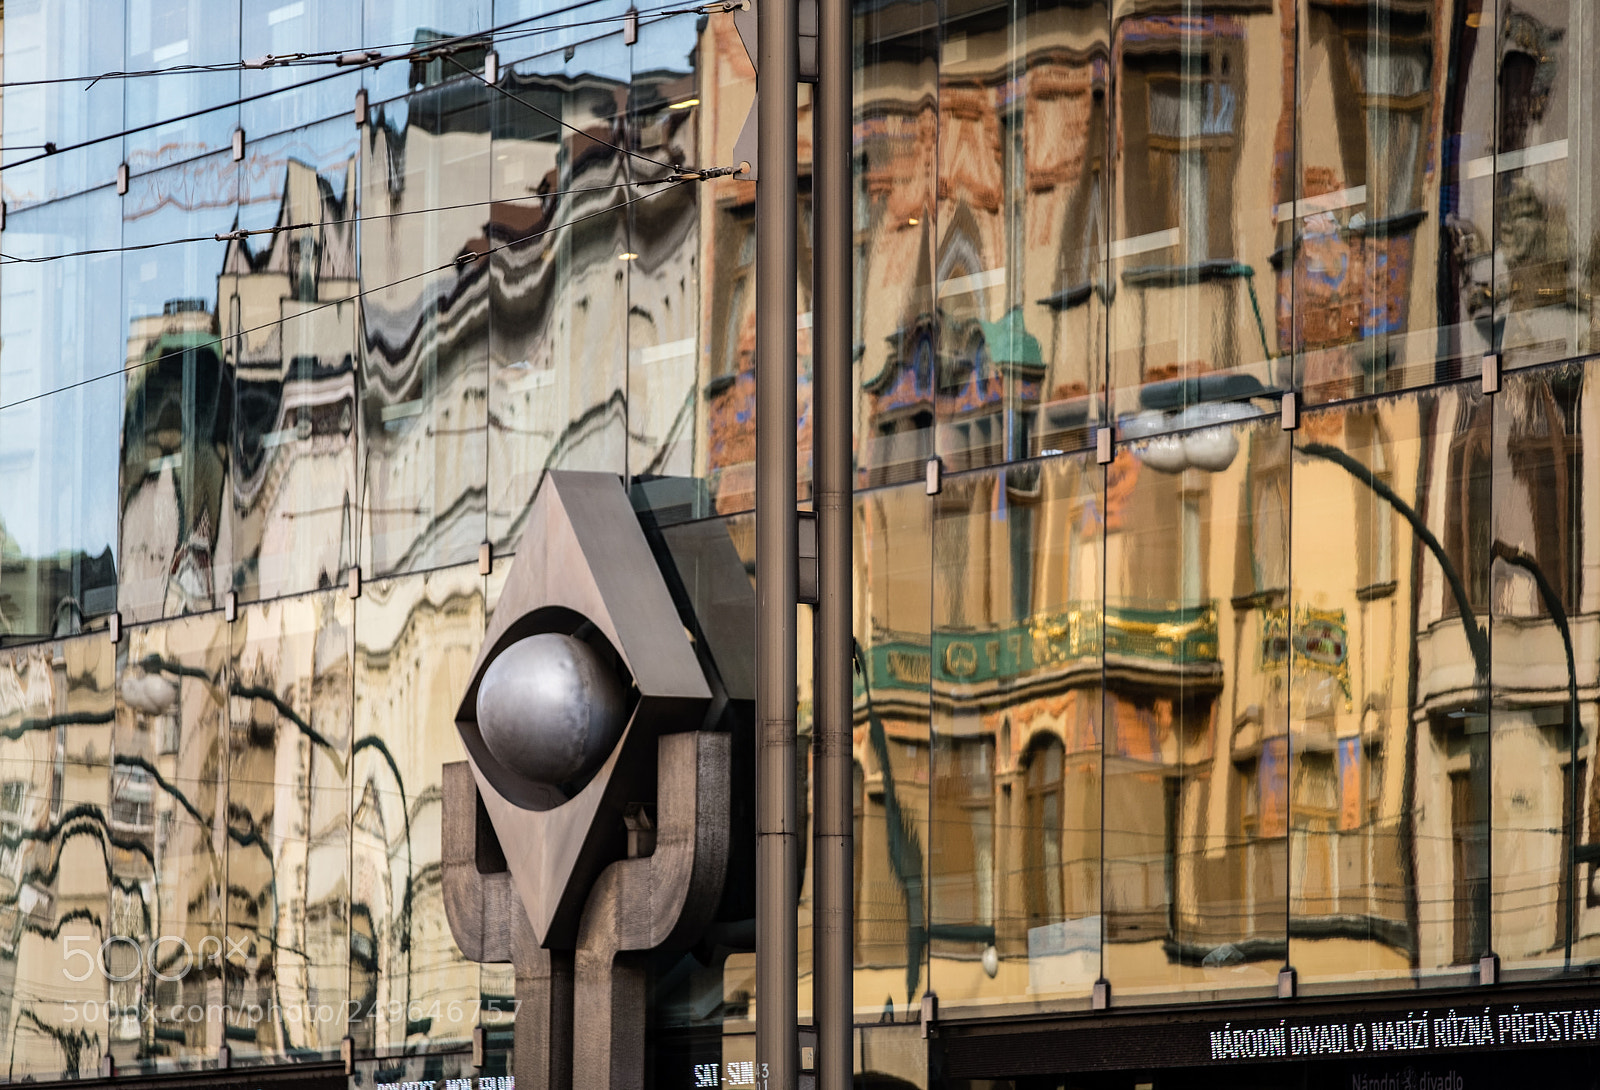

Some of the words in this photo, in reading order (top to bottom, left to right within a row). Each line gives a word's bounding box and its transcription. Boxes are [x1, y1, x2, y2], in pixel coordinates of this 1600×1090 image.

[1210, 1019, 1286, 1060] NÁRODNÍ
[1290, 1023, 1367, 1056] DIVADLO
[1371, 1010, 1429, 1051] NABÍZÍ
[1434, 1006, 1495, 1048] RŮZNÁ
[1498, 1004, 1600, 1045] PŘEDSTAV
[1352, 1072, 1400, 1090] Národní
[1419, 1069, 1464, 1090] divadlo
